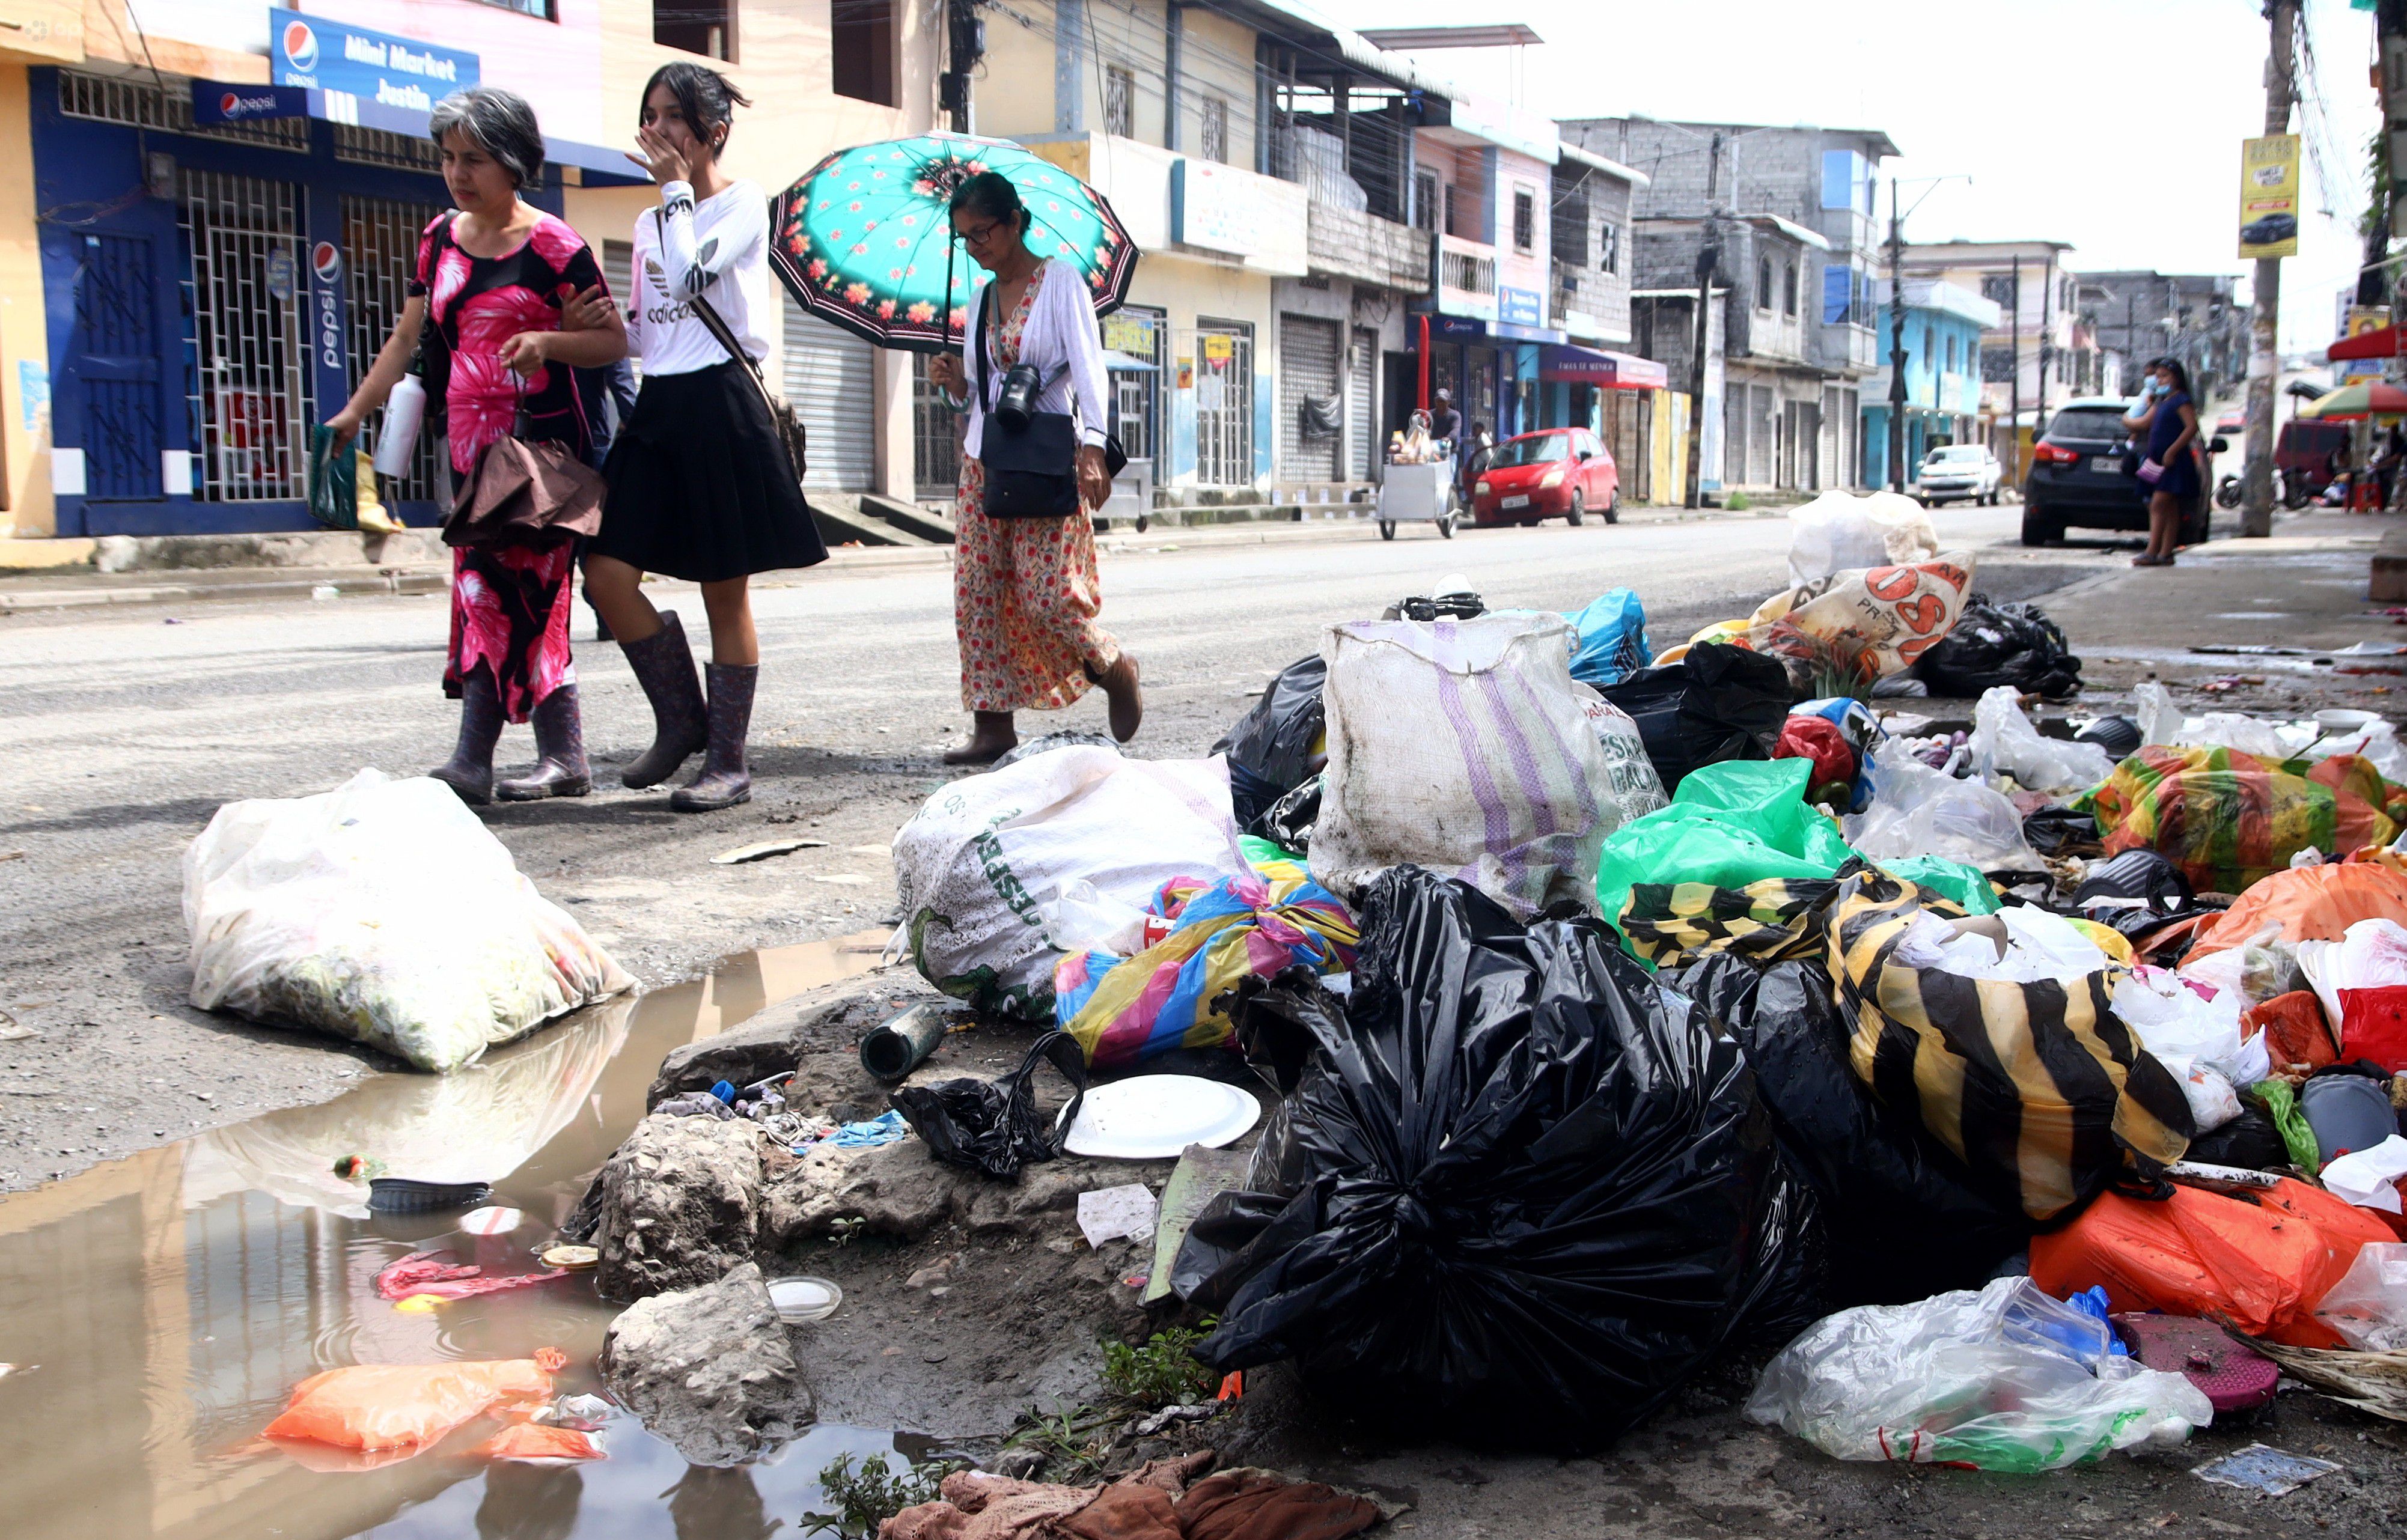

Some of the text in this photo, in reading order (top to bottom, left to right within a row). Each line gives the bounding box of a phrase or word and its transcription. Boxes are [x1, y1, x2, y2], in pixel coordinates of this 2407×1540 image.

[344, 34, 457, 82] Mini Market
[240, 94, 277, 113] pepsi
[376, 77, 432, 111] Justin
[316, 288, 343, 369] pepsi
